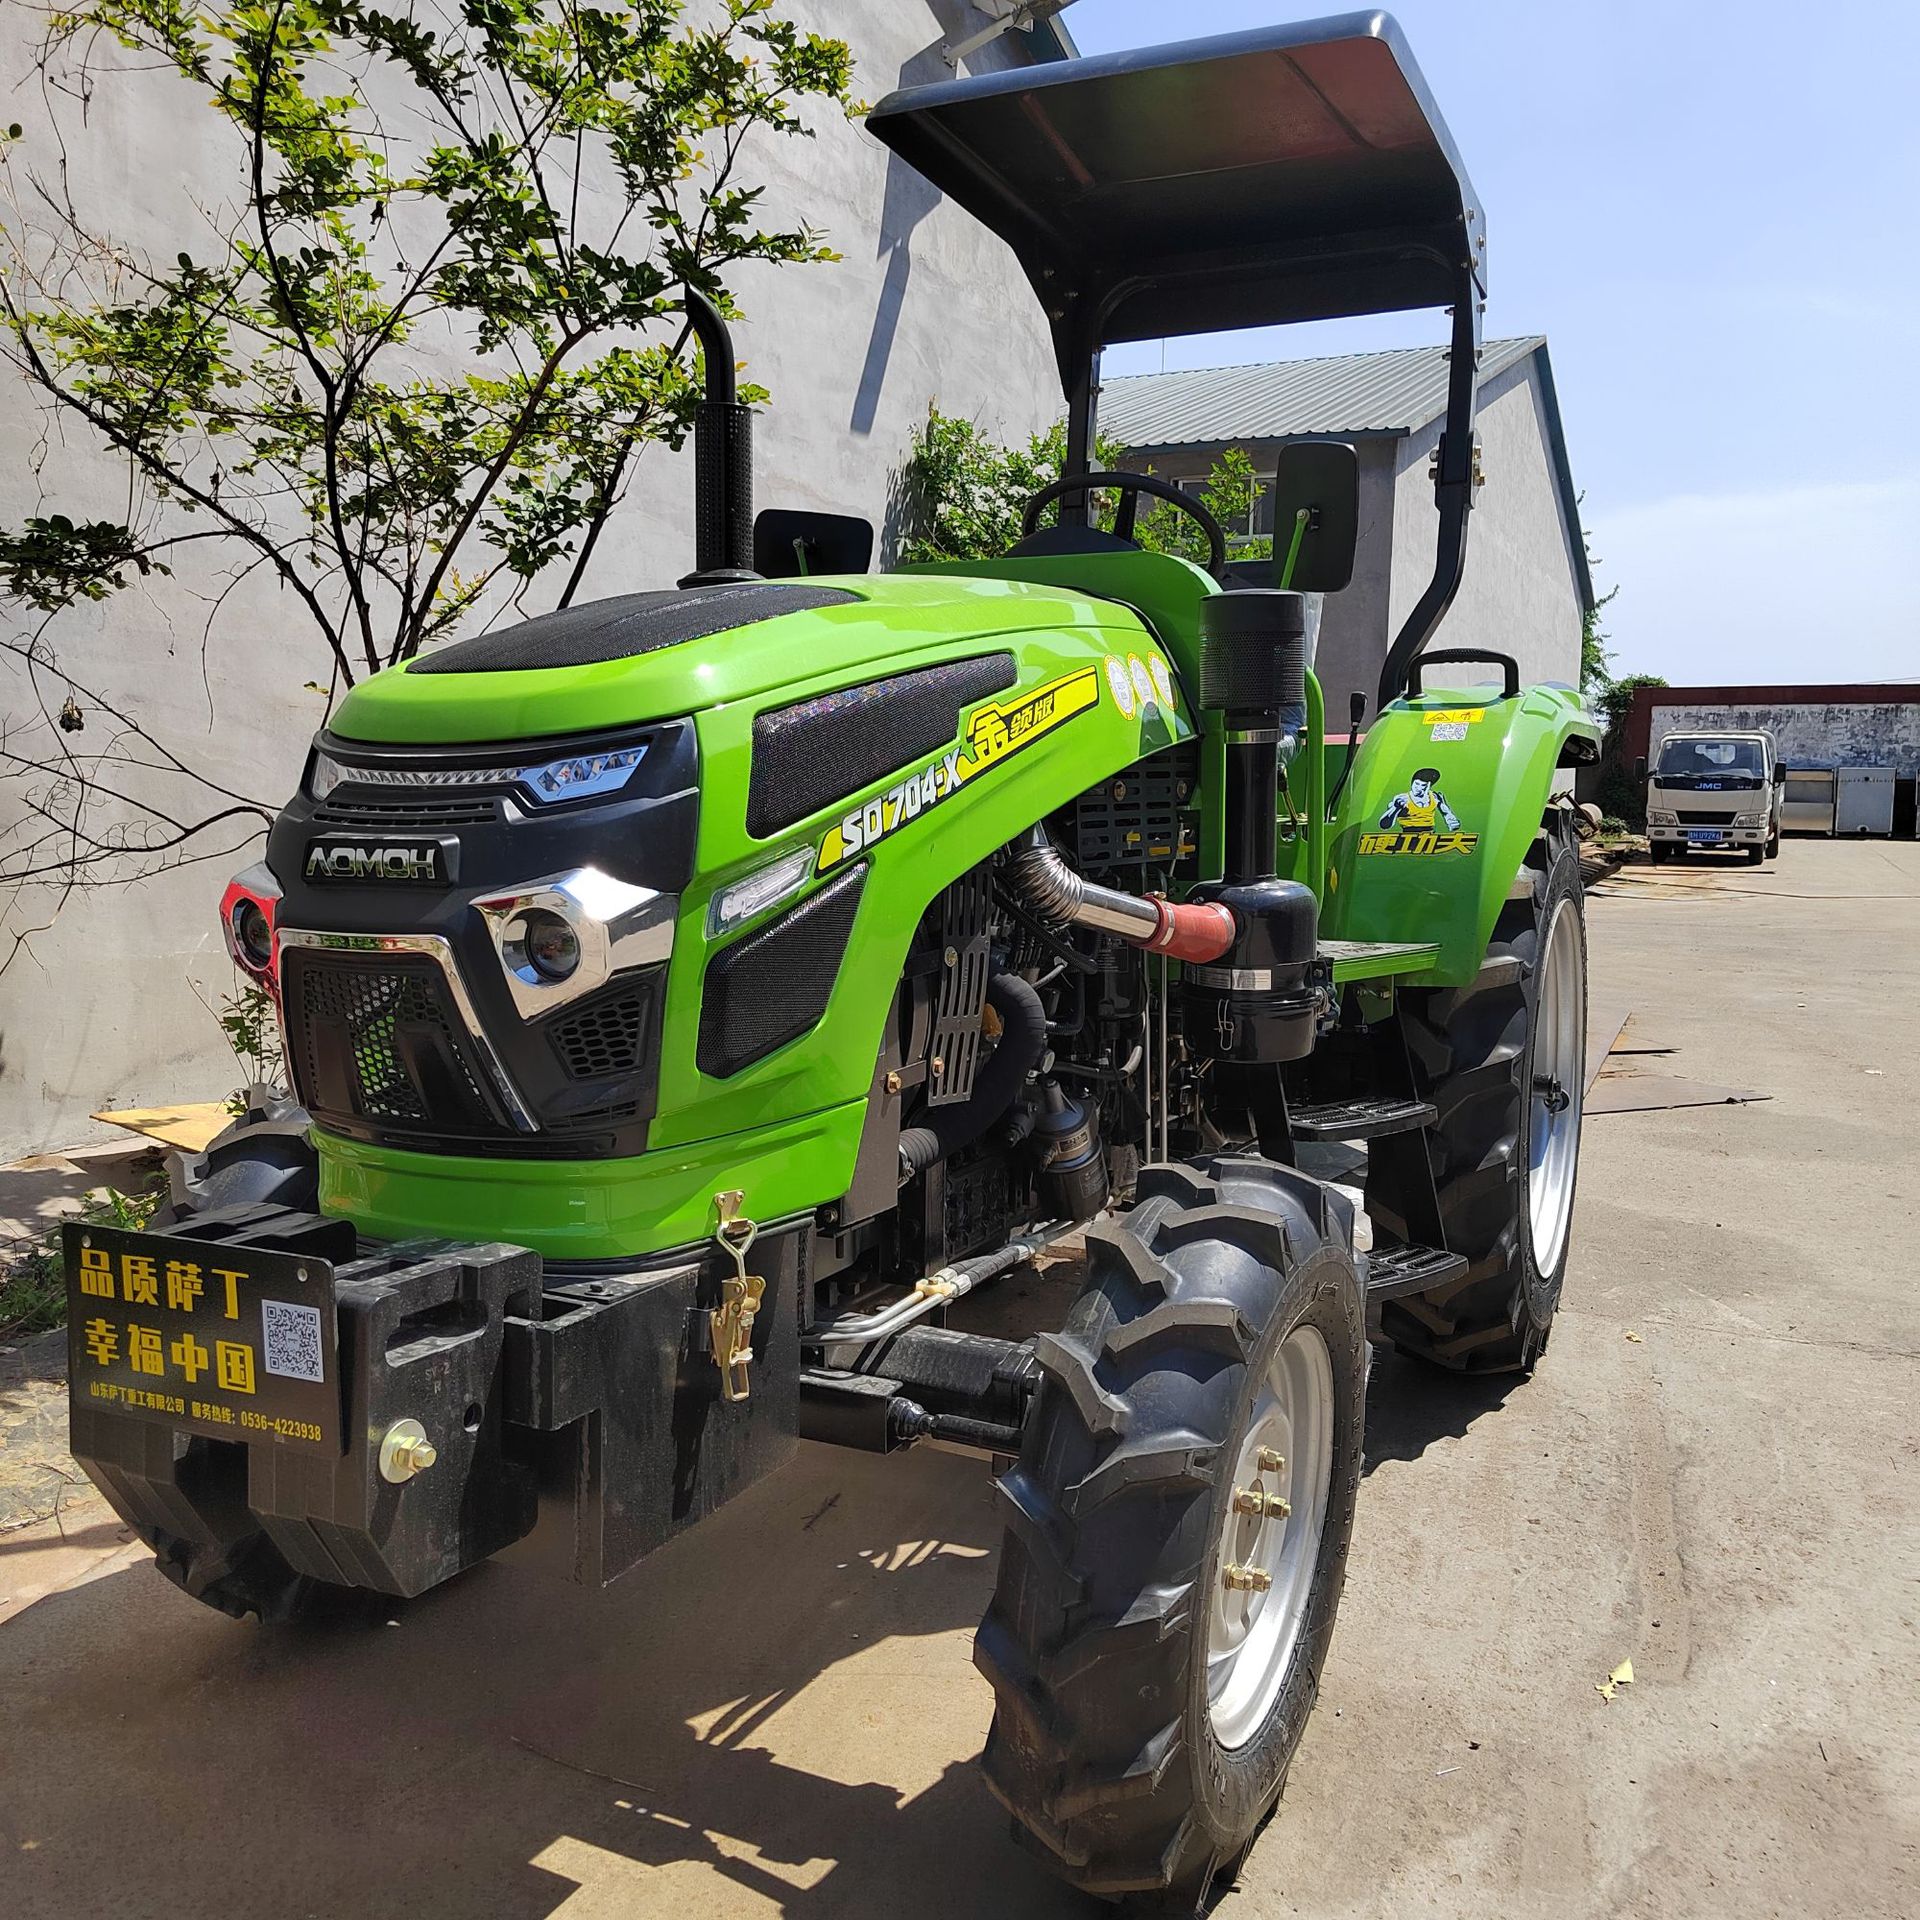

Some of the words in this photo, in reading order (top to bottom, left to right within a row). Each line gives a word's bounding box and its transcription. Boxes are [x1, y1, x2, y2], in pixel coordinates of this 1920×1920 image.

[1358, 832, 1477, 855] 硬功夫
[80, 1248, 249, 1320] 品质萨丁
[85, 1318, 256, 1394] 幸福中国
[90, 1381, 185, 1415] 山东萨丁重工有限公司
[240, 1410, 322, 1442] 0536-4223938
